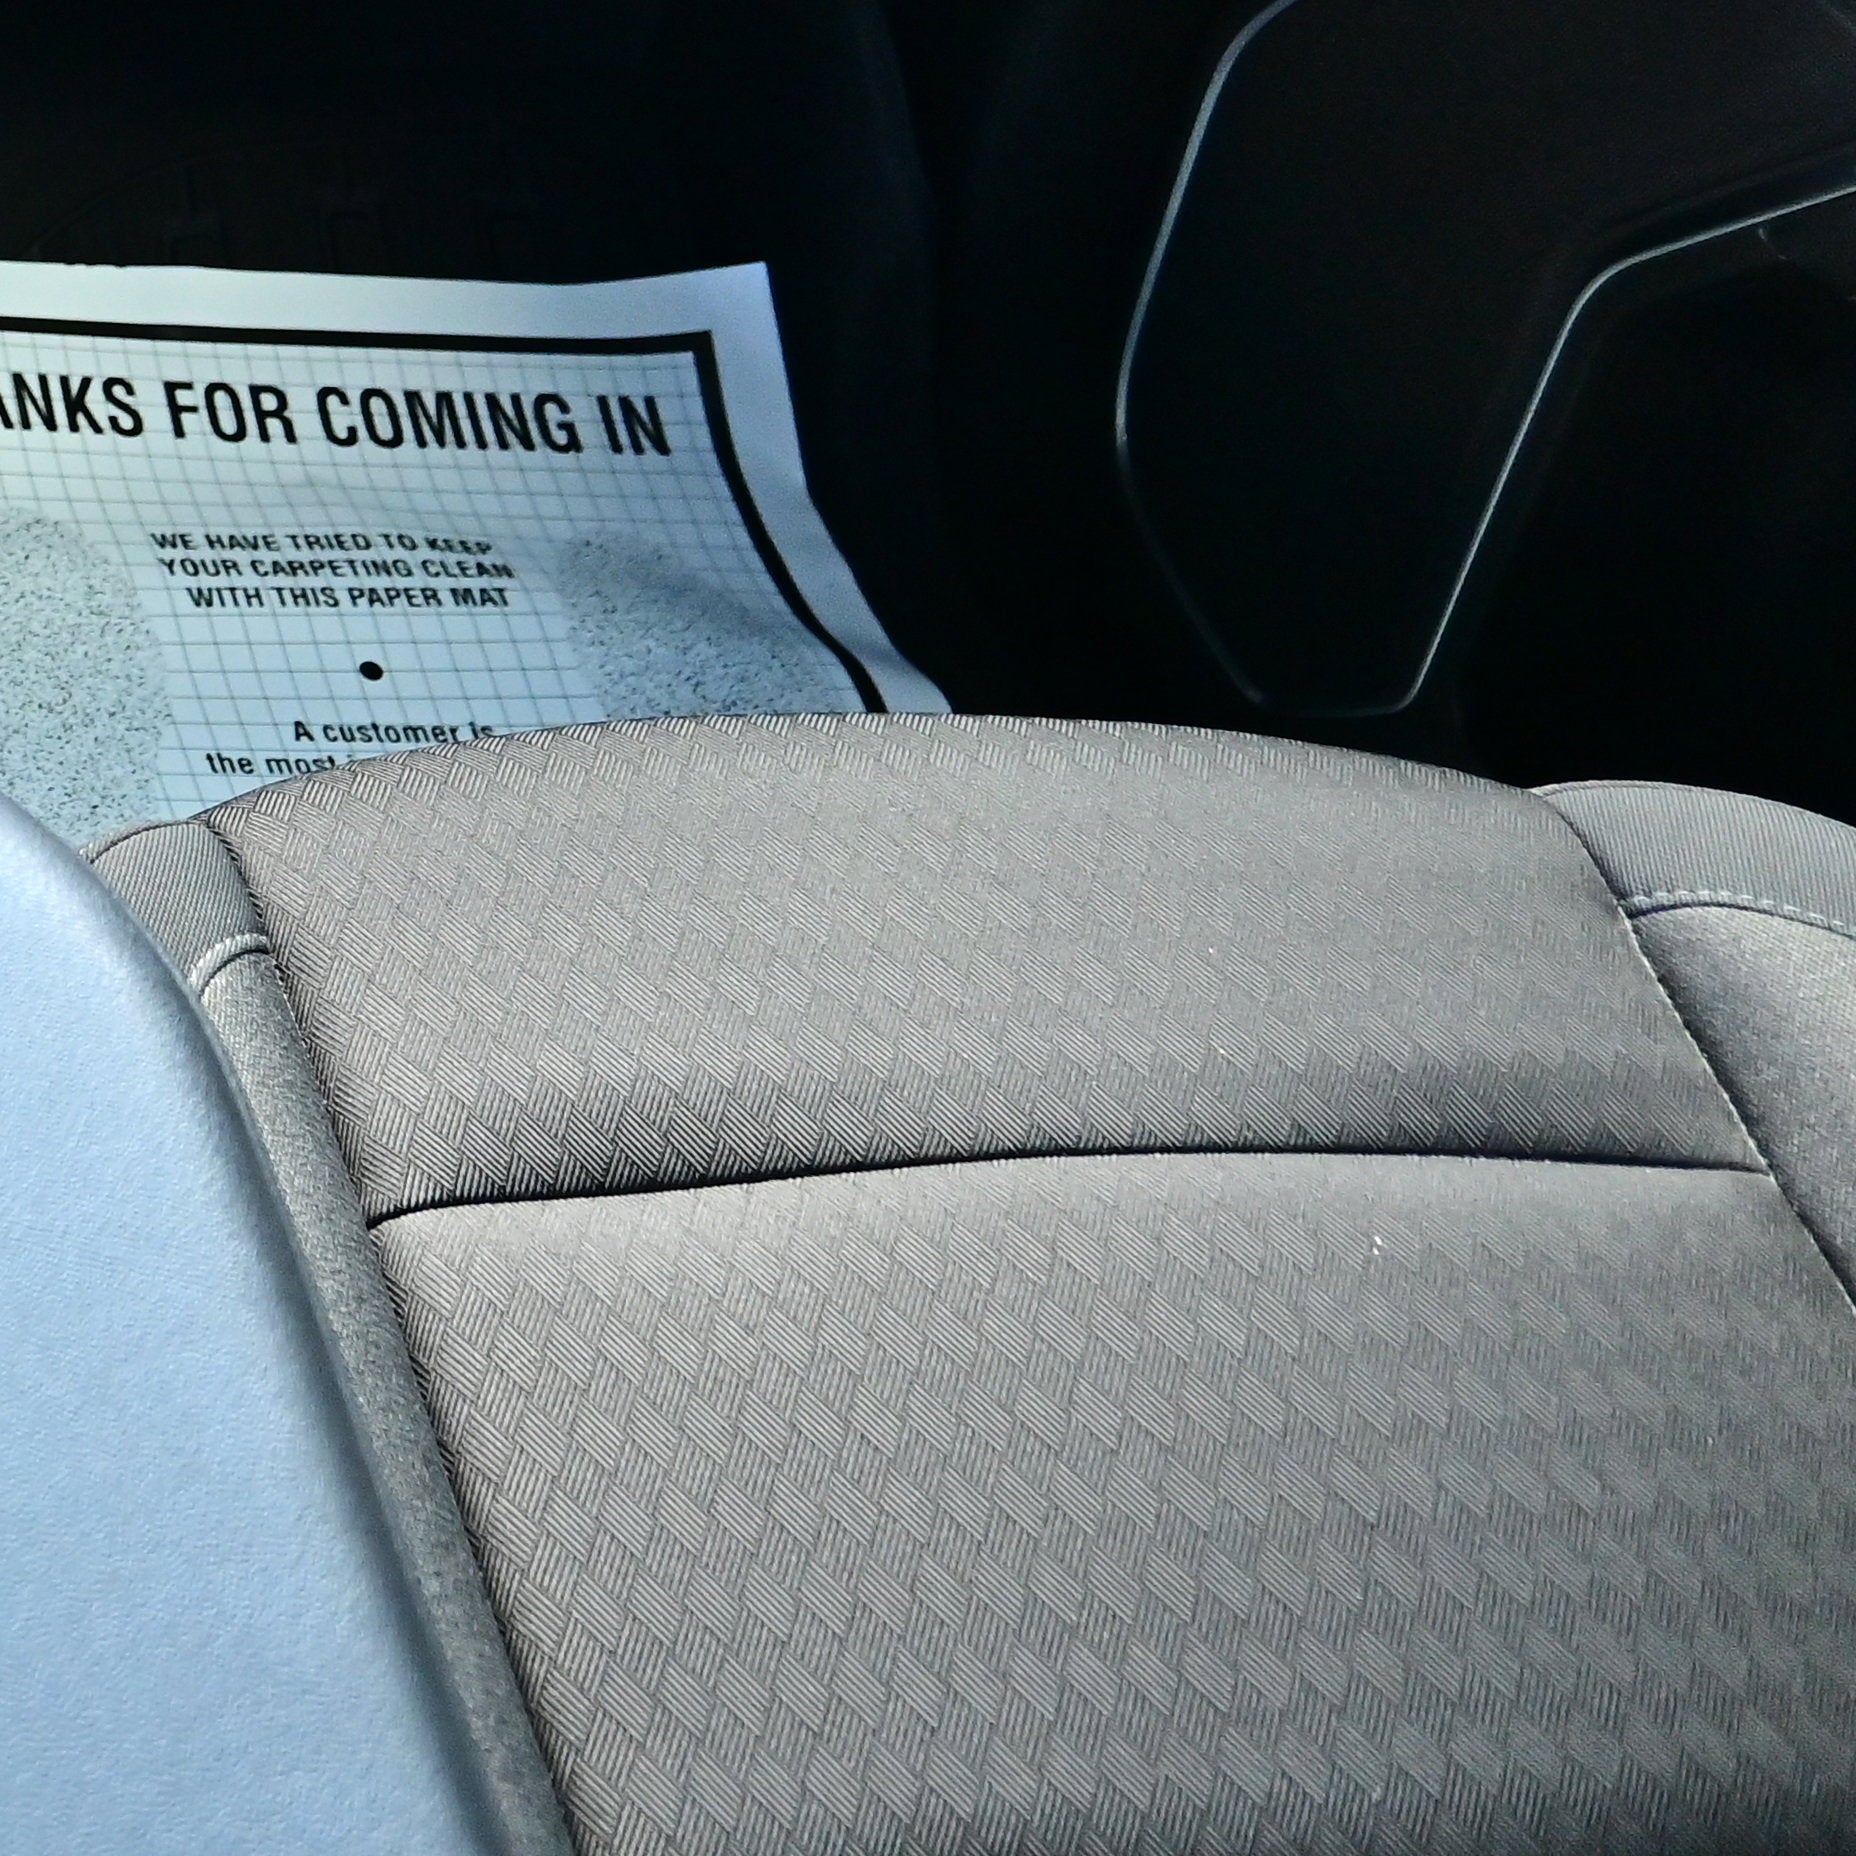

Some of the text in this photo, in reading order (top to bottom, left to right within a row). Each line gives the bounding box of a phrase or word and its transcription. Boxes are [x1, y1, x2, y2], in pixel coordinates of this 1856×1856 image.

[162, 380, 298, 446] FOR
[315, 384, 585, 455] COMING
[595, 393, 673, 457] IN
[150, 533, 493, 556] WE HAVE TRIED TO KEEP
[158, 557, 515, 579] YOUR CARPETING CLEAN
[187, 586, 510, 609] WITH THIS PAPER MAT
[293, 720, 315, 742] A
[322, 722, 461, 744] customer
[205, 752, 337, 777] the most
